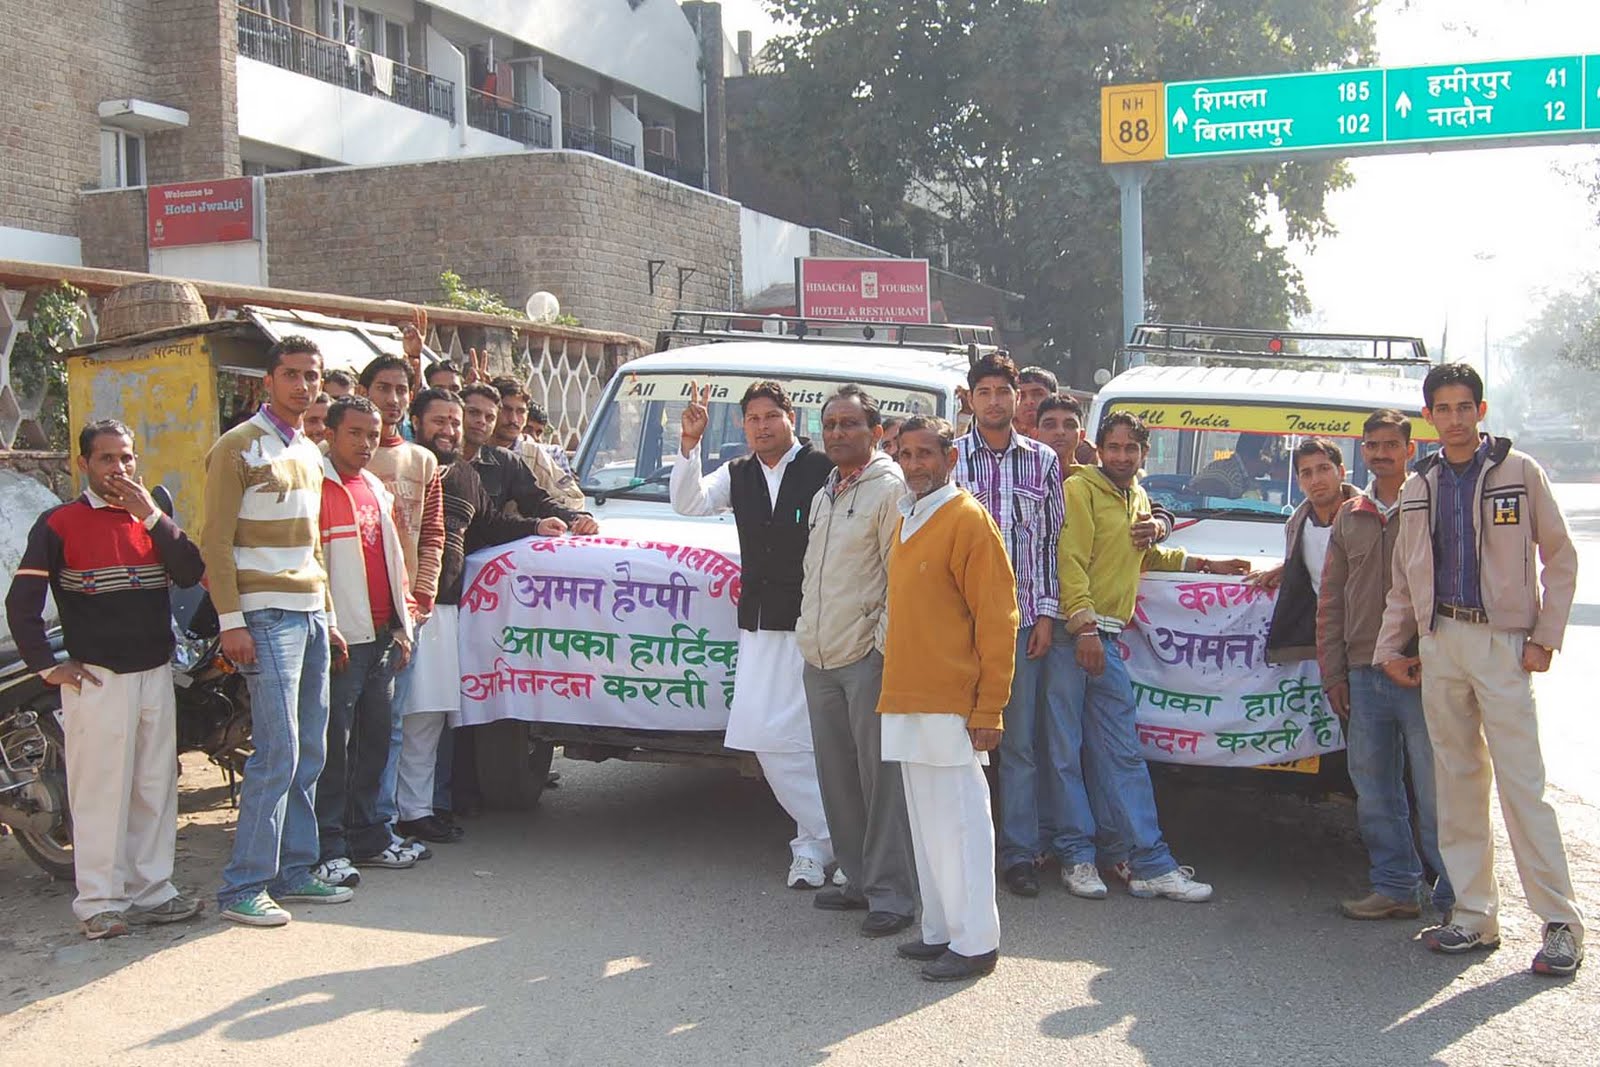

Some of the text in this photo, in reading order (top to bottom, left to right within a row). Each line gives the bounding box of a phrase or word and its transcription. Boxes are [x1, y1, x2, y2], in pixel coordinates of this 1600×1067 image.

[1427, 66, 1566, 99] हमीरपुर 41
[1122, 98, 1144, 111] NH
[1193, 81, 1370, 113] शिमला 185
[1544, 101, 1566, 121] 12
[1119, 119, 1149, 143] 88
[1192, 113, 1370, 146] बिलासपुर 102
[164, 188, 214, 199] Welcome to
[165, 198, 244, 215] Hotel Jwalaji
[806, 283, 924, 293] HIMACHAL TOURISM
[811, 306, 927, 317] HOTEL & RESTAURANT
[628, 383, 656, 397] All
[788, 389, 824, 404] rist
[1137, 409, 1351, 432] All India Tourist
[1495, 498, 1517, 523] H
[510, 574, 606, 612] अमन
[492, 625, 621, 664] आपका
[1147, 627, 1260, 671] अमन
[460, 657, 597, 701] अभिनन्दन
[602, 669, 709, 709] करती
[1214, 718, 1303, 754] करती
